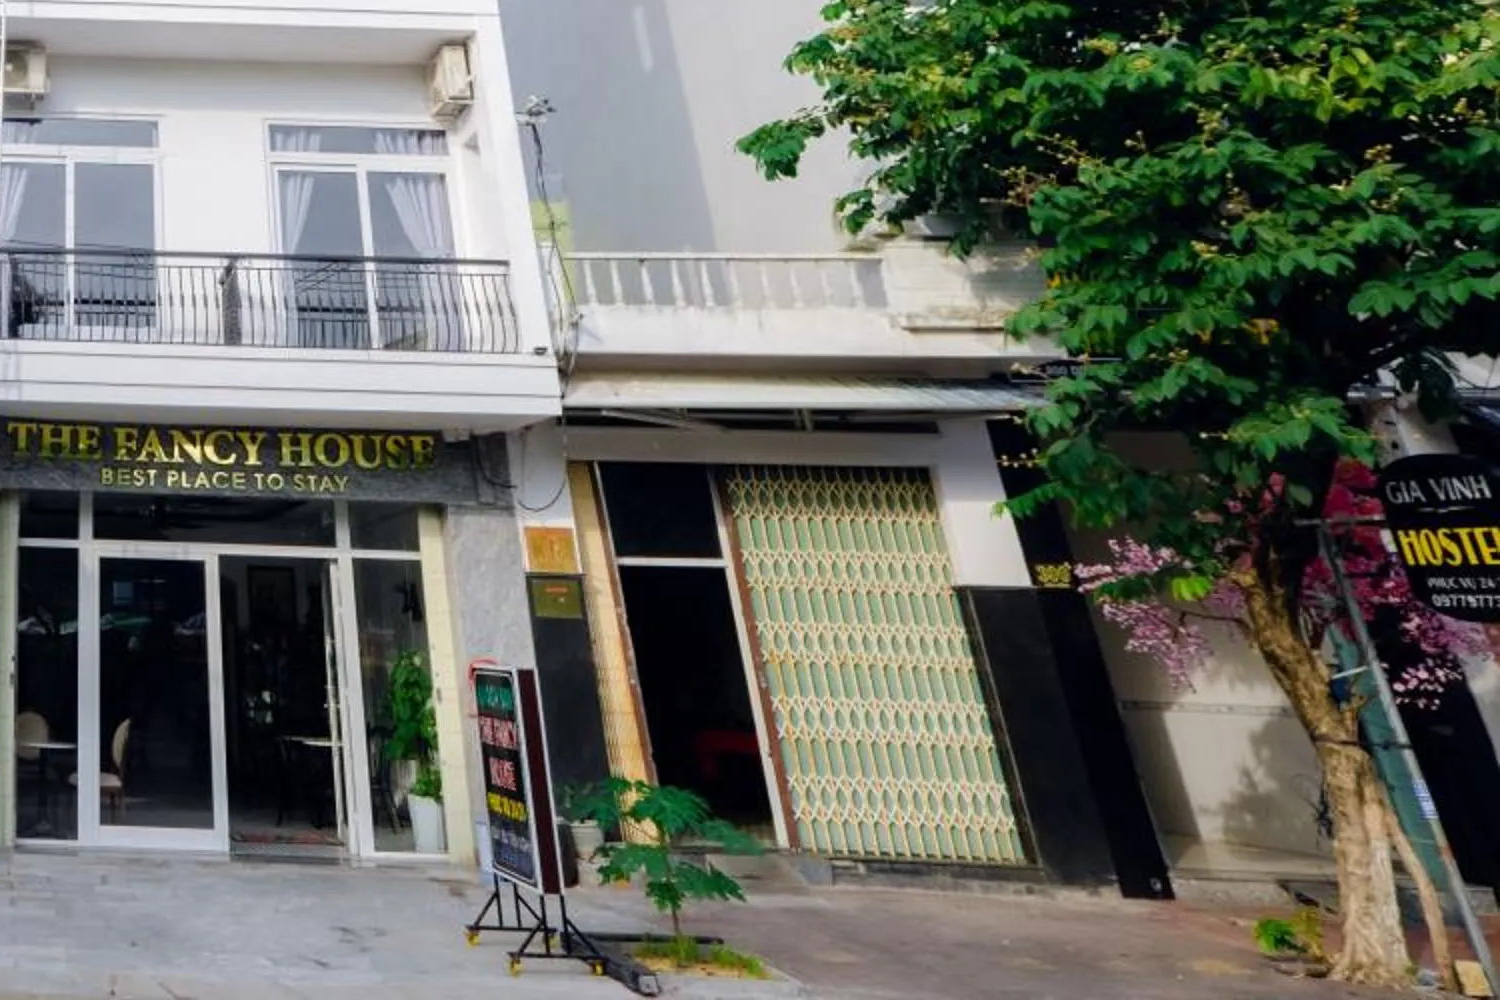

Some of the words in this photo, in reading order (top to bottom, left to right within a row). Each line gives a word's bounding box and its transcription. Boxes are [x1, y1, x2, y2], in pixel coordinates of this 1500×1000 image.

[7, 422, 101, 460] THE
[112, 427, 266, 466] FANCY
[278, 431, 435, 469] HOUSE
[101, 468, 157, 487] BEST
[167, 470, 246, 490] PLACE
[254, 472, 285, 491] TO
[293, 474, 349, 493] STAY
[1385, 480, 1428, 504] GIA
